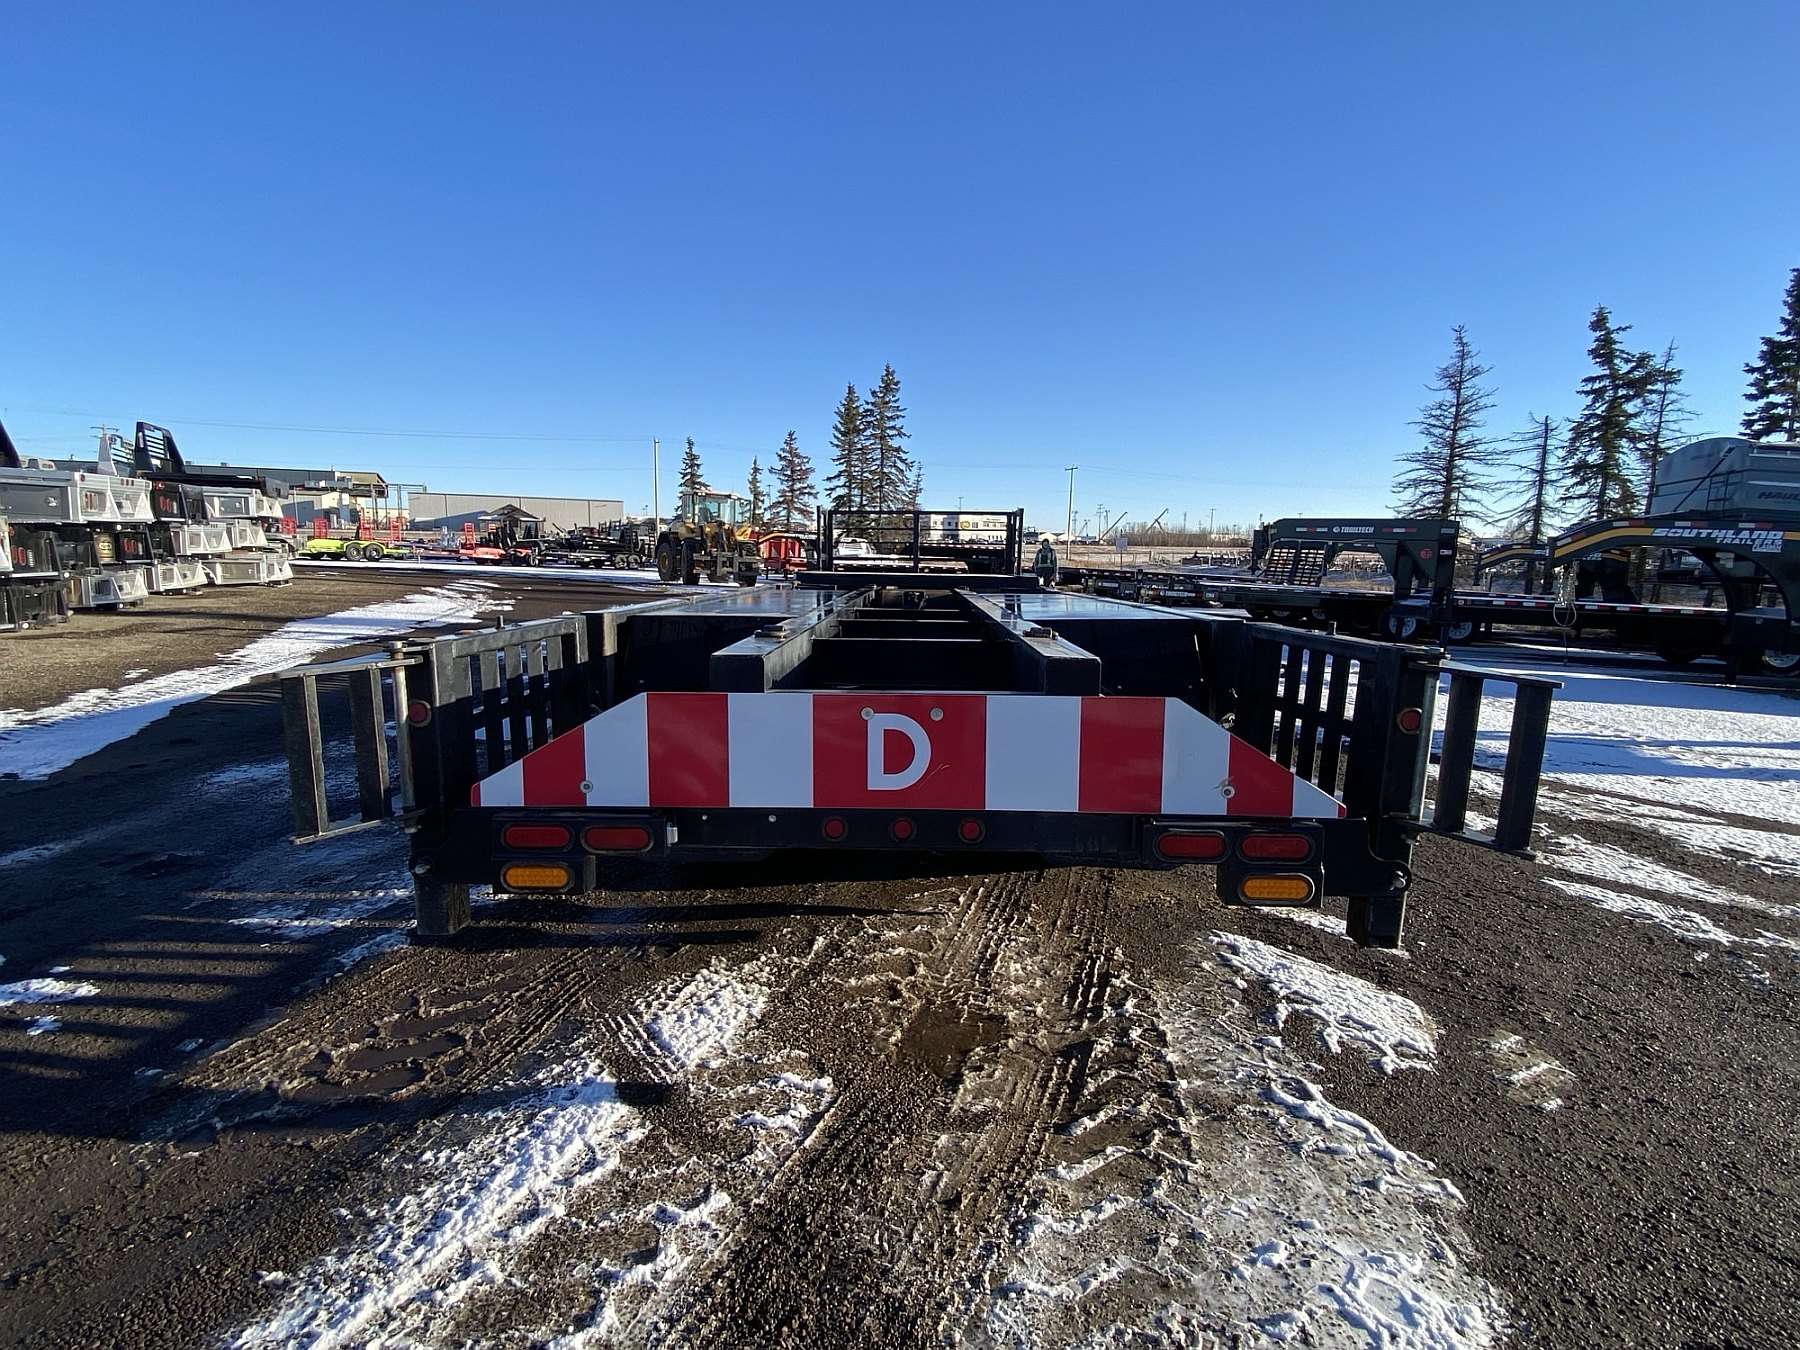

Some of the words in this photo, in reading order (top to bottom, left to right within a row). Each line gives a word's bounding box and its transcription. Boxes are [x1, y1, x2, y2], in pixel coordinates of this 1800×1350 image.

[1652, 528, 1784, 539] SOUTHLAND
[1716, 538, 1783, 546] TRAILERS
[867, 712, 932, 790] D
